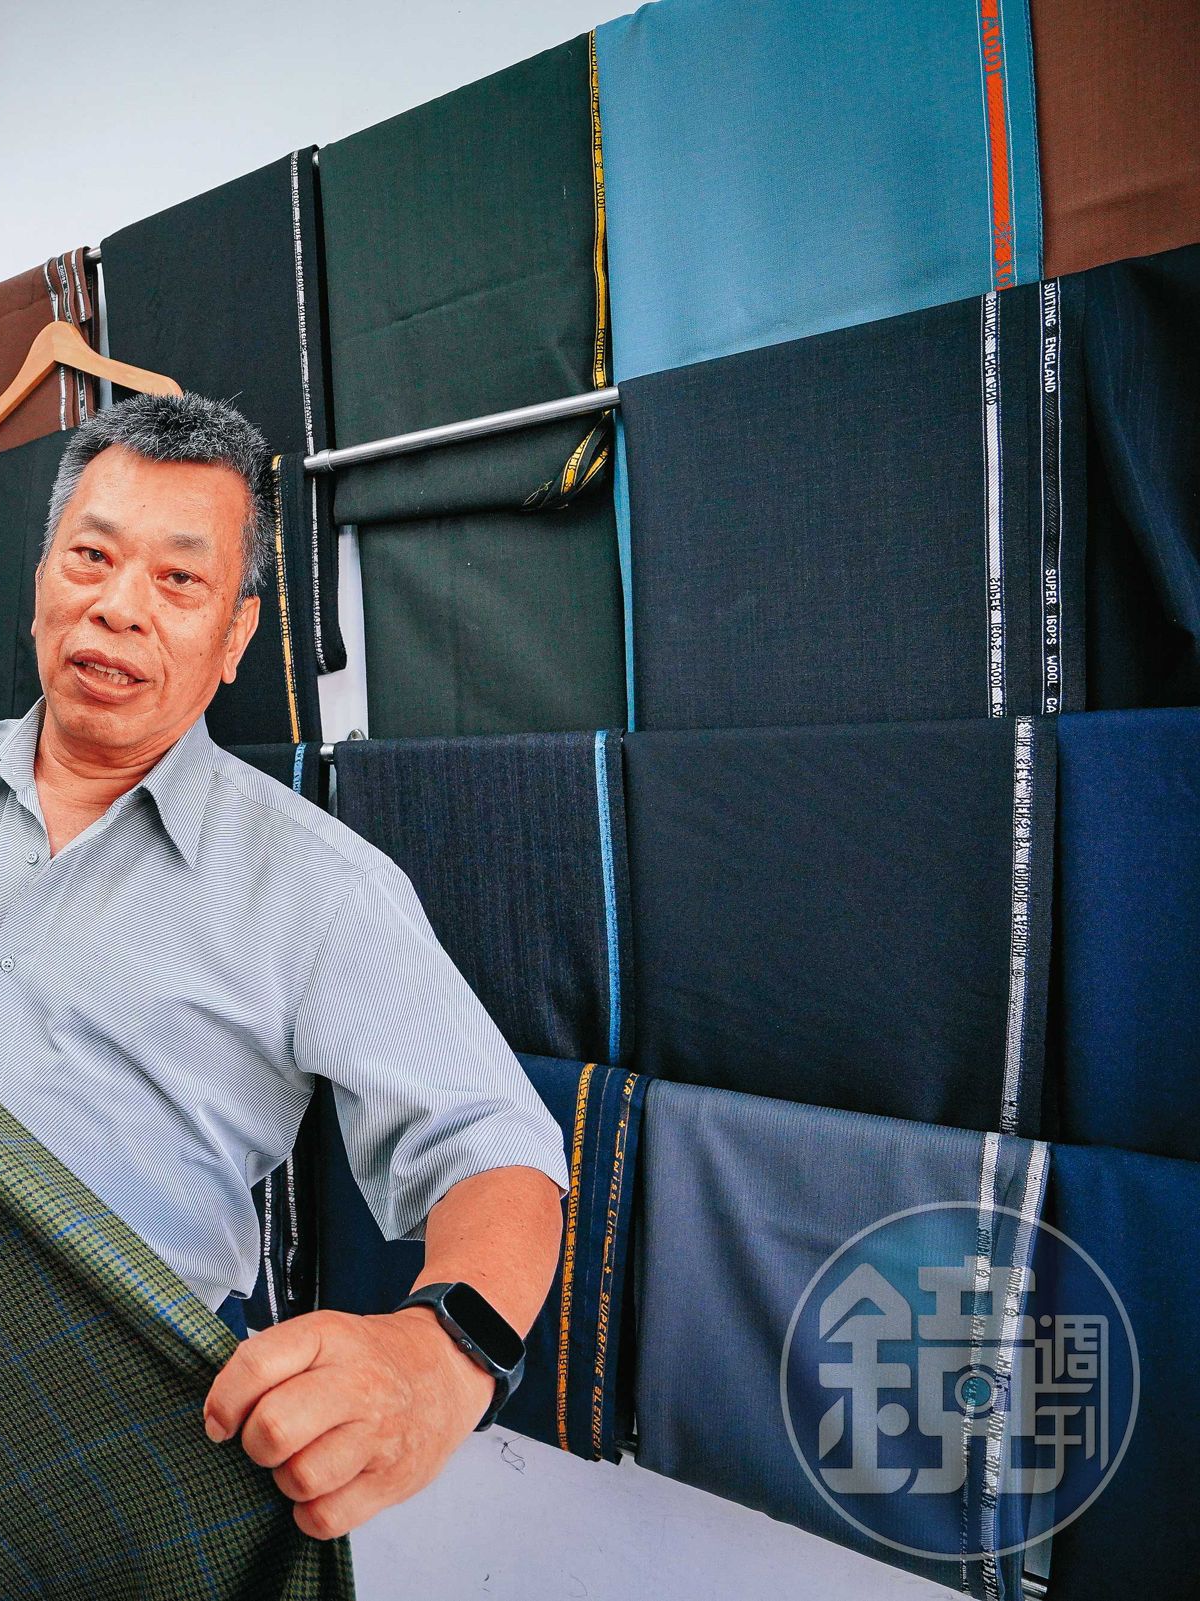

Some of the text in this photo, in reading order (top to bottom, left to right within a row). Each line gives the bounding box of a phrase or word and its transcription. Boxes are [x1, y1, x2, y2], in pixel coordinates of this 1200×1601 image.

[1044, 282, 1057, 393] SUITING ENGLAND
[1045, 569, 1057, 605] SUPER
[1046, 655, 1058, 690] WOOL
[1046, 697, 1058, 714] CA
[594, 1291, 610, 1377] SUPERFINE
[590, 1386, 604, 1449] BLENDED
